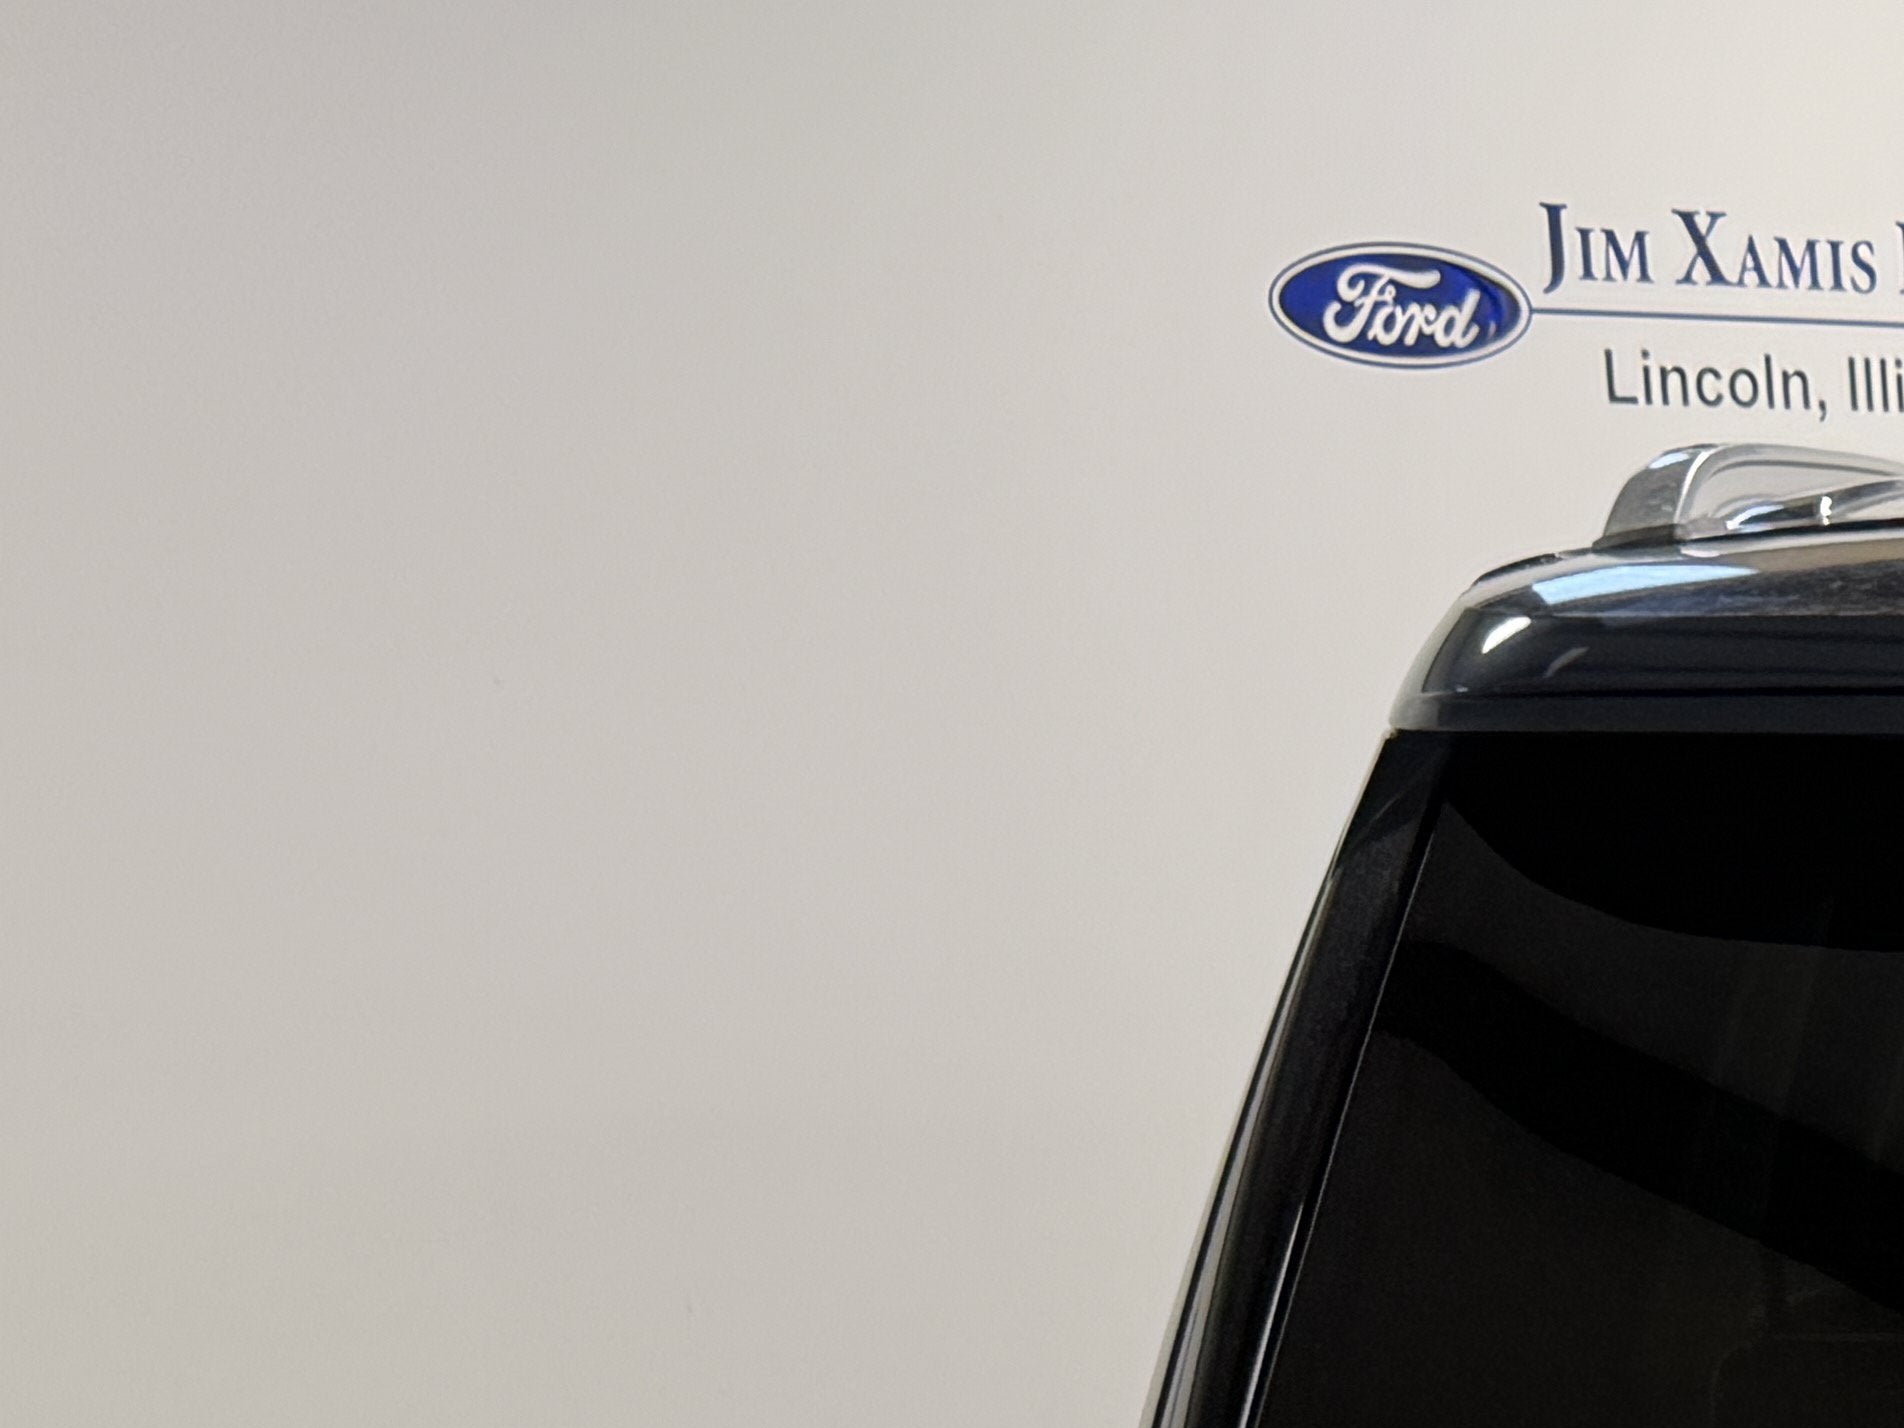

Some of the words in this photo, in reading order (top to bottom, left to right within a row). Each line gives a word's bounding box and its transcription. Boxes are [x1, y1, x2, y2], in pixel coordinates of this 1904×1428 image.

[1539, 202, 1653, 295] JIM
[1671, 208, 1877, 295] XAMIS
[1603, 348, 1827, 422] Lincoln,
